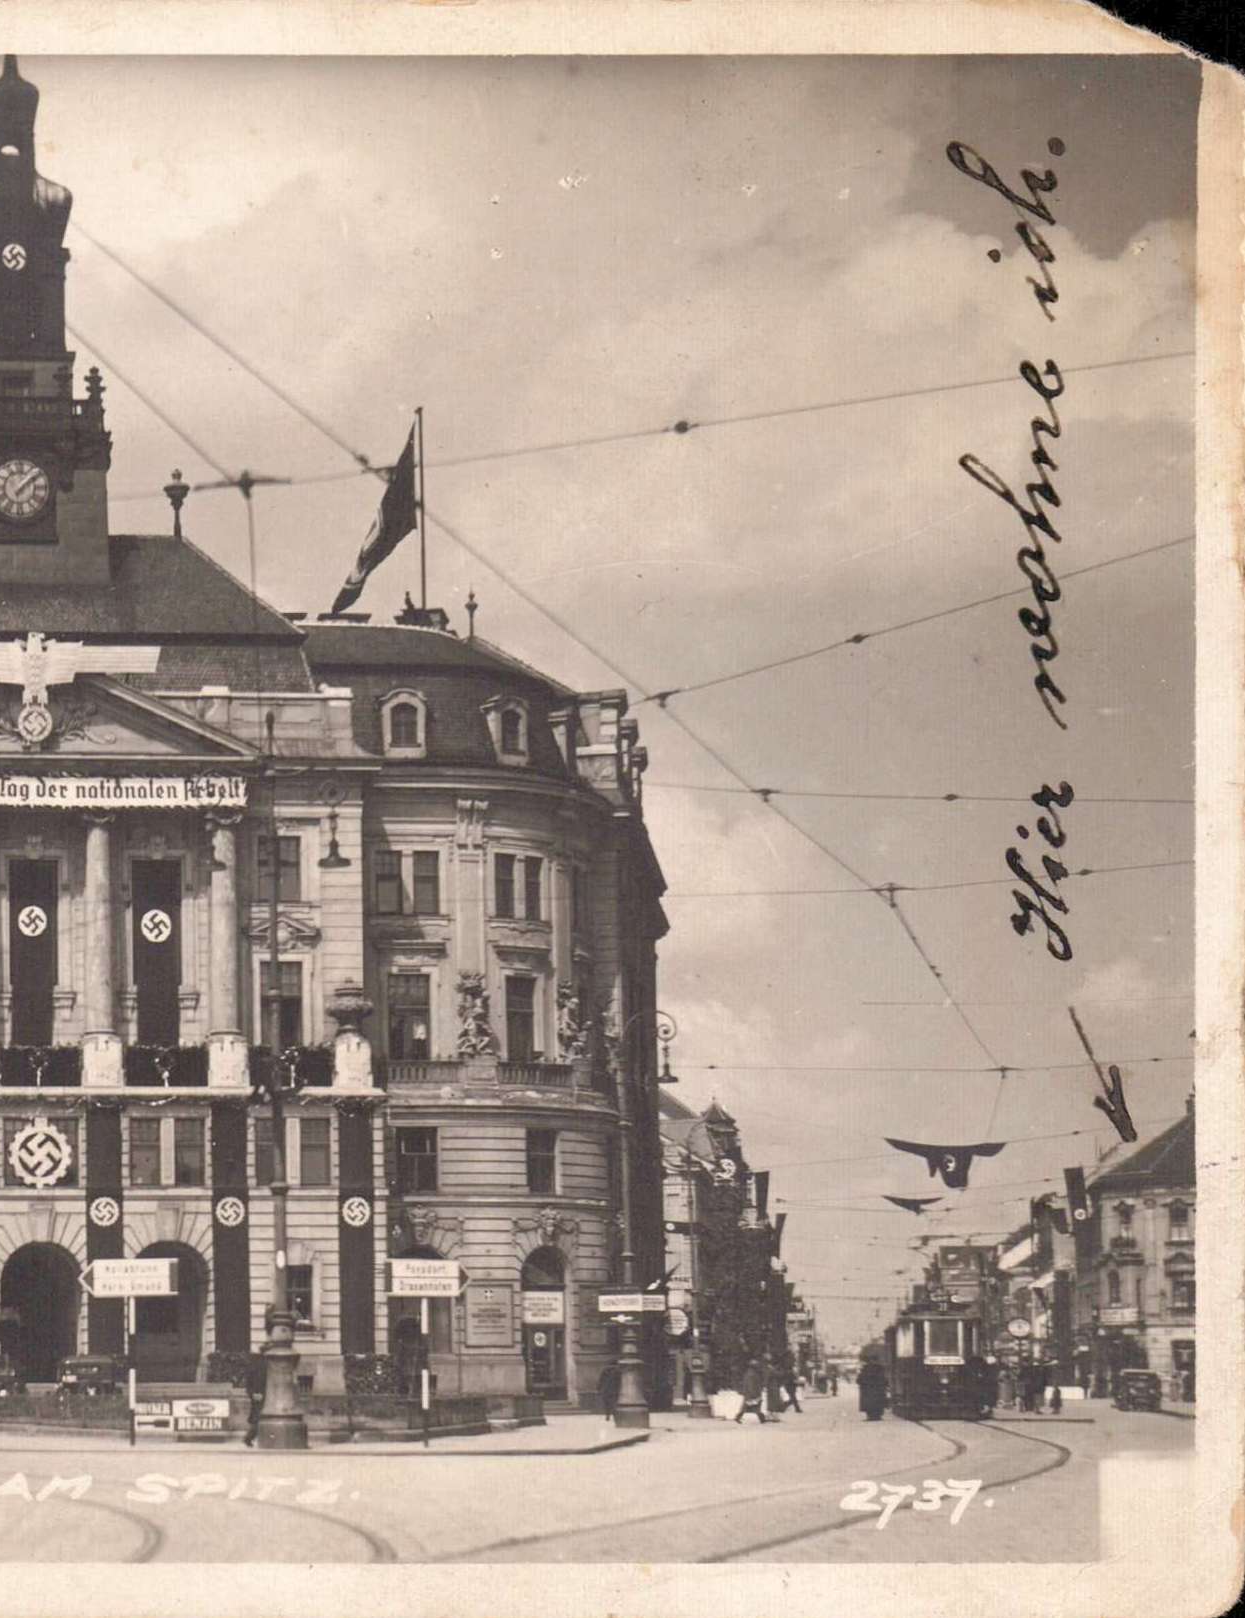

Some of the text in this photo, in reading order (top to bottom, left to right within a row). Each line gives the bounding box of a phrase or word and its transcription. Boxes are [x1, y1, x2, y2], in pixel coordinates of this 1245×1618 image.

[946, 136, 1068, 323] ich.
[0, 775, 30, 801] Tag
[36, 776, 69, 799] der
[75, 776, 178, 800] nationalen
[1005, 779, 1073, 962] Hier
